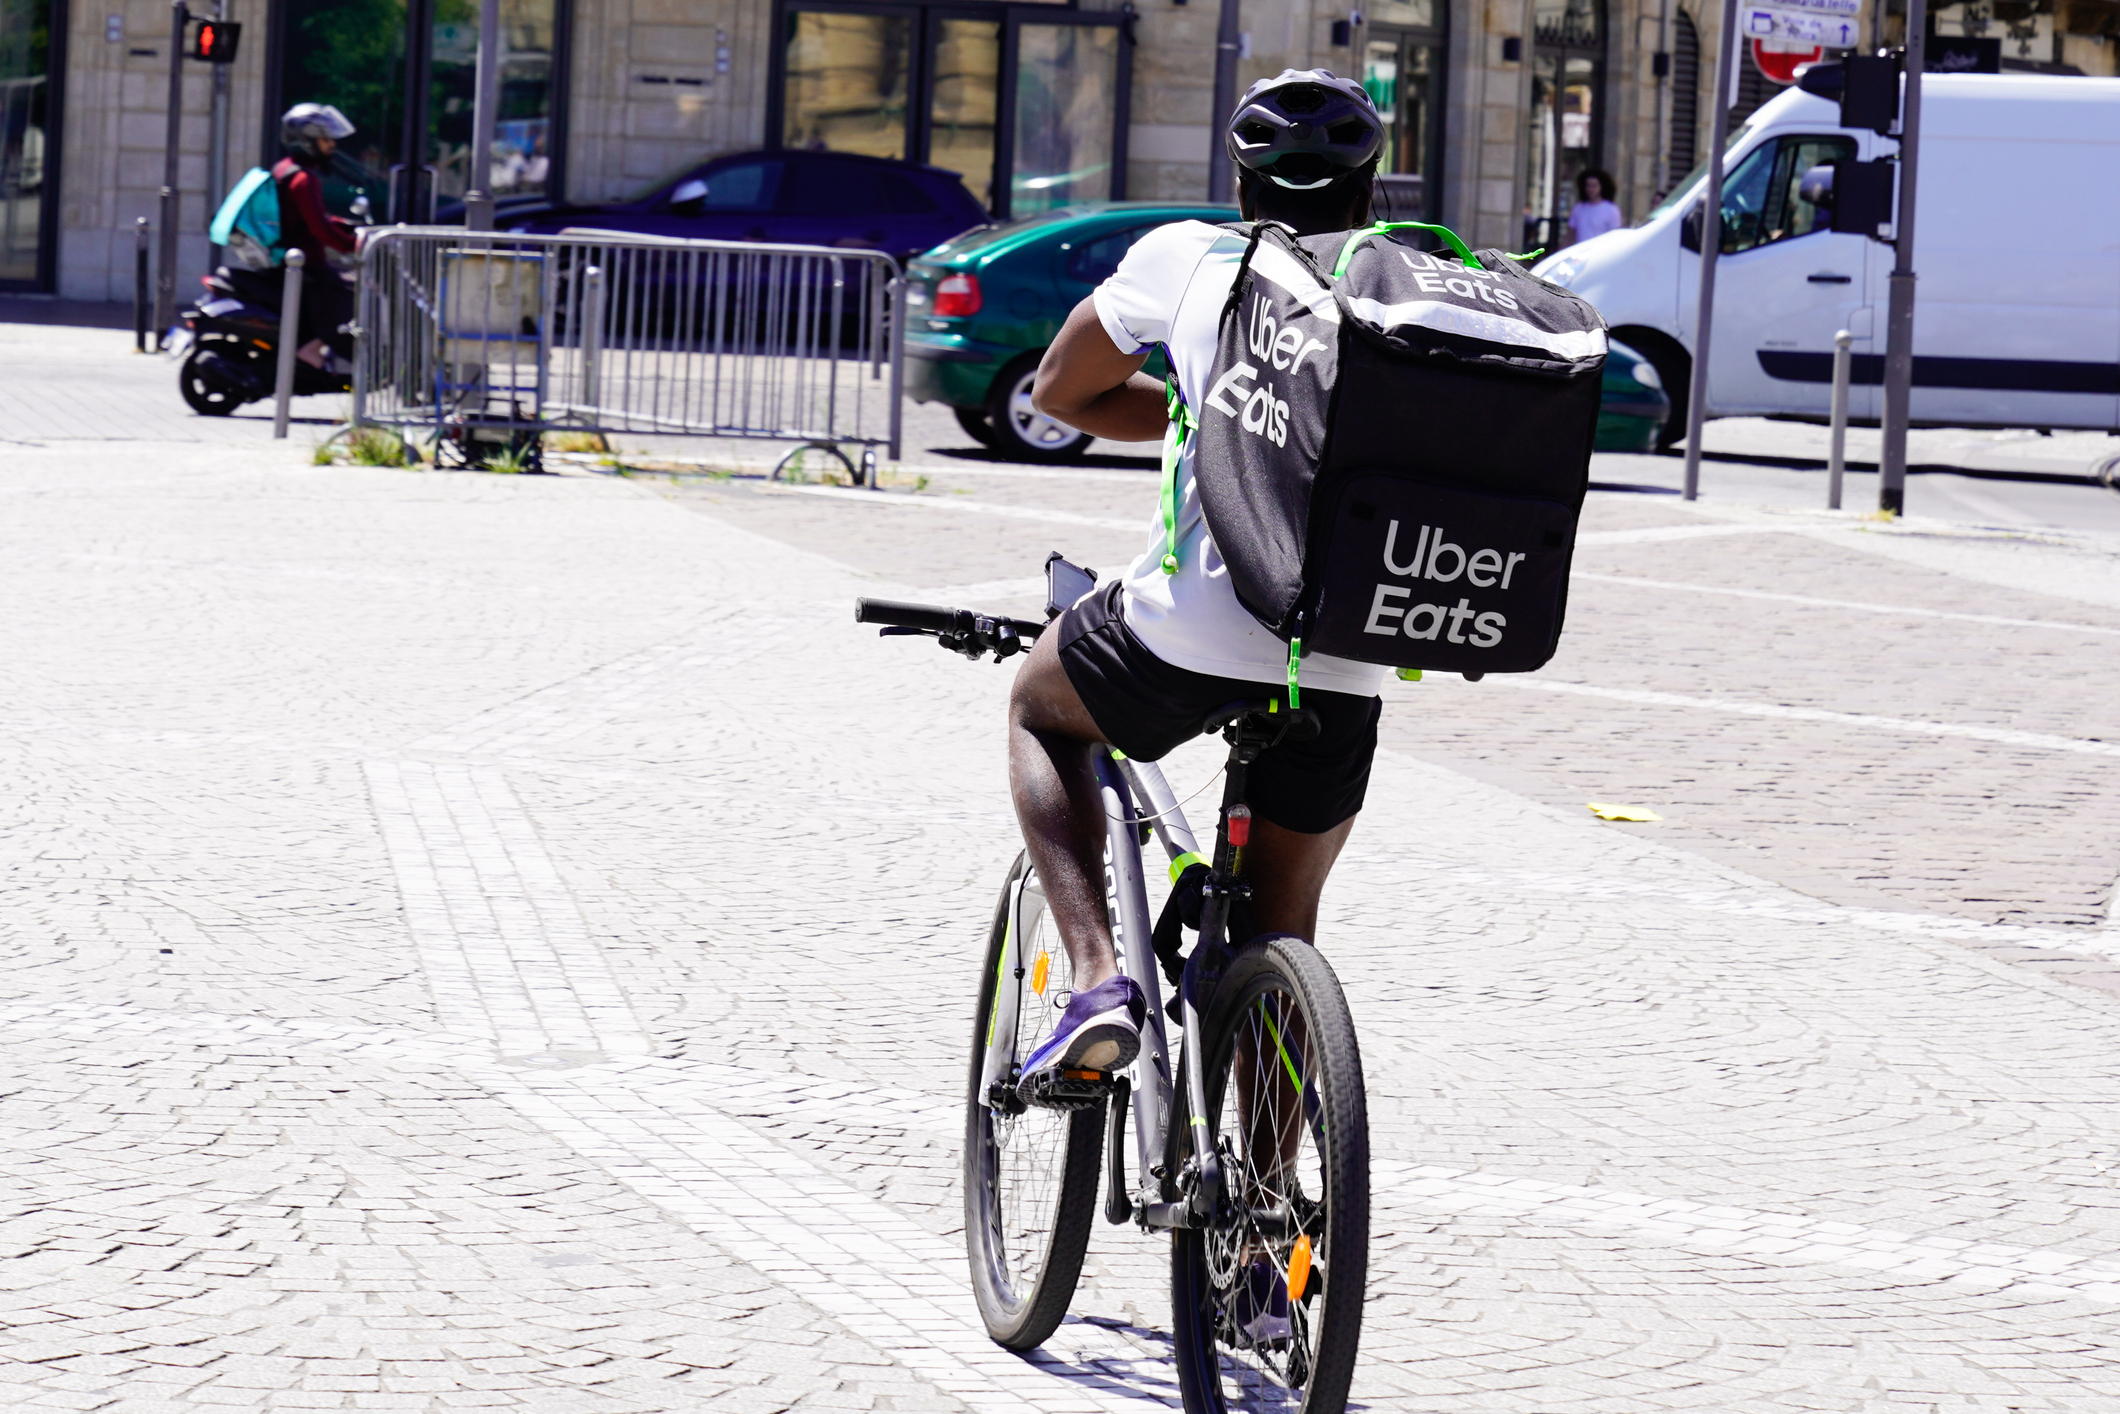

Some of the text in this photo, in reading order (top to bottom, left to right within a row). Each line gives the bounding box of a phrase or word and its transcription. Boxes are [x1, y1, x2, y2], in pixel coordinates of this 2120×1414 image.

[1399, 251, 1502, 282] Uber
[1412, 272, 1519, 310] Eats
[1250, 292, 1328, 375] Uber
[1205, 361, 1290, 448] Eats
[1383, 519, 1526, 590] Uber
[1363, 583, 1507, 648] Eats
